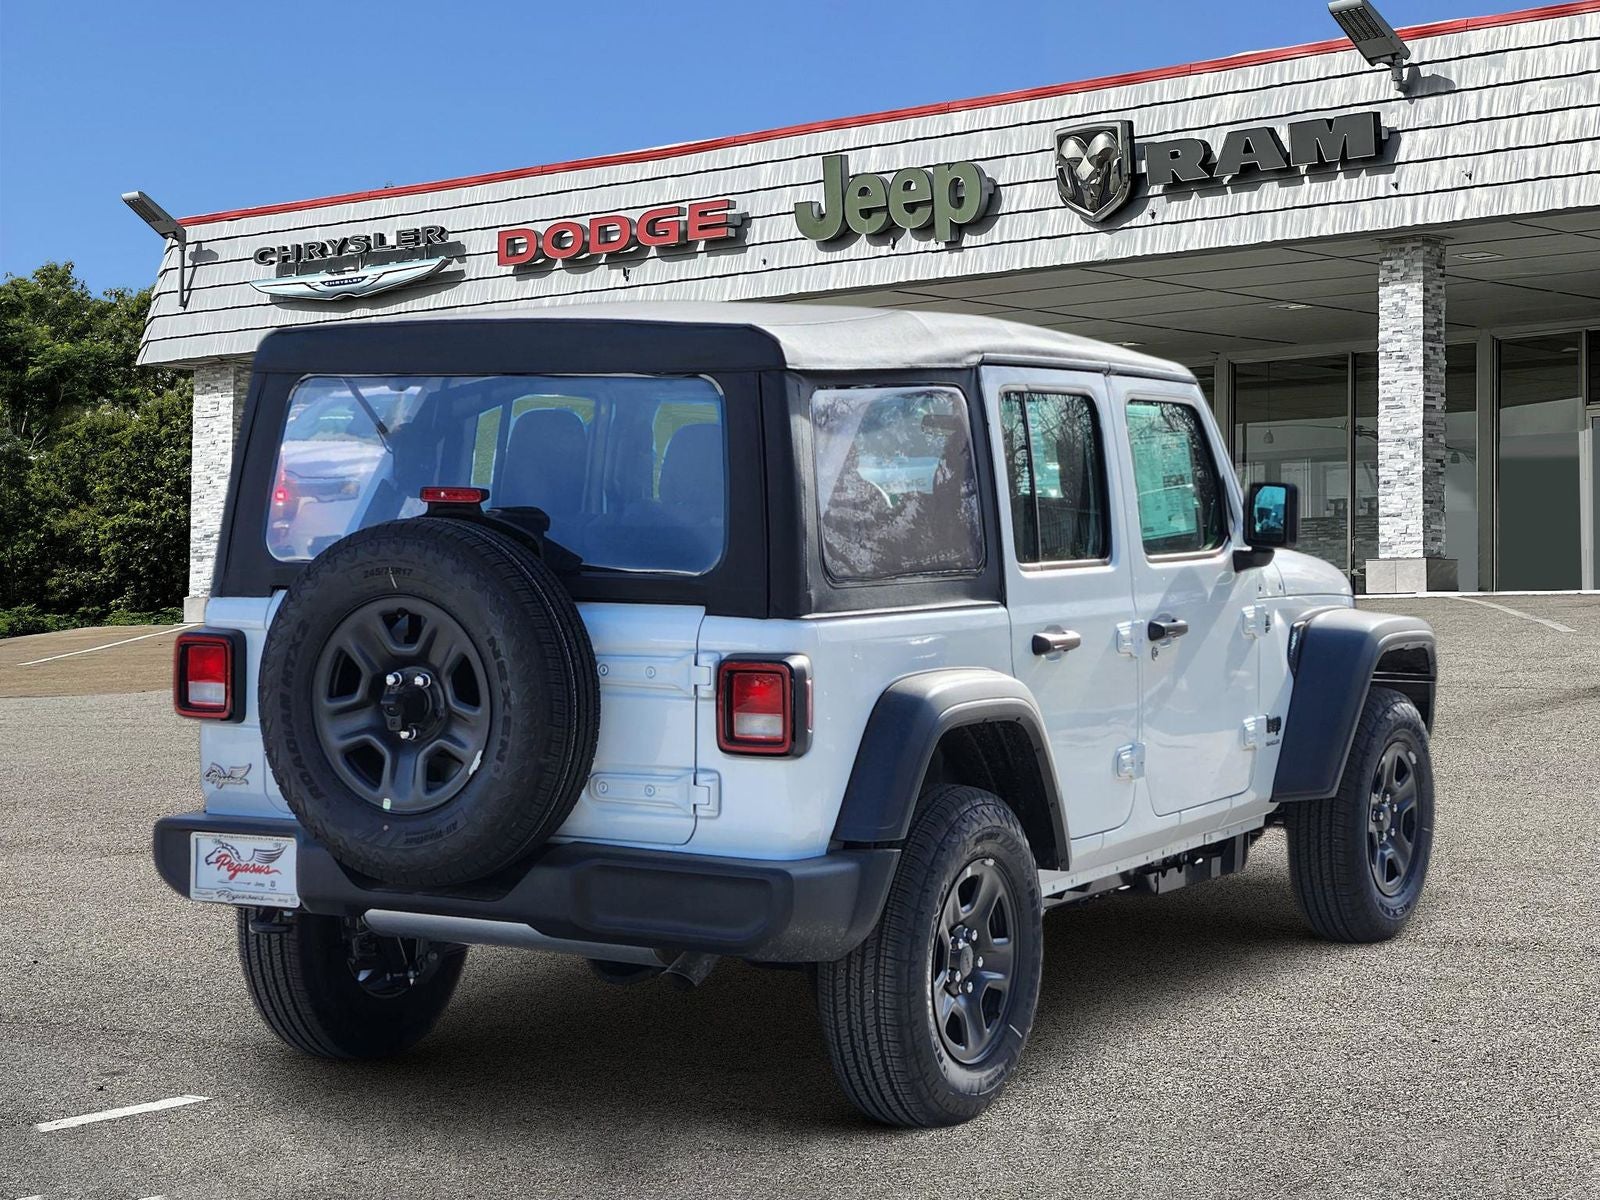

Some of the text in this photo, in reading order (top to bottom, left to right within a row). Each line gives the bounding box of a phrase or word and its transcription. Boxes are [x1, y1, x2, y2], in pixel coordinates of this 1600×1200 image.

[1144, 111, 1382, 187] RAM
[794, 154, 988, 242] Jeep
[253, 225, 449, 266] CHRYSLER
[497, 199, 736, 267] DODGE
[324, 277, 363, 286] CHRYSLER
[487, 635, 512, 763] NEXEN
[216, 853, 282, 881] Pegasus
